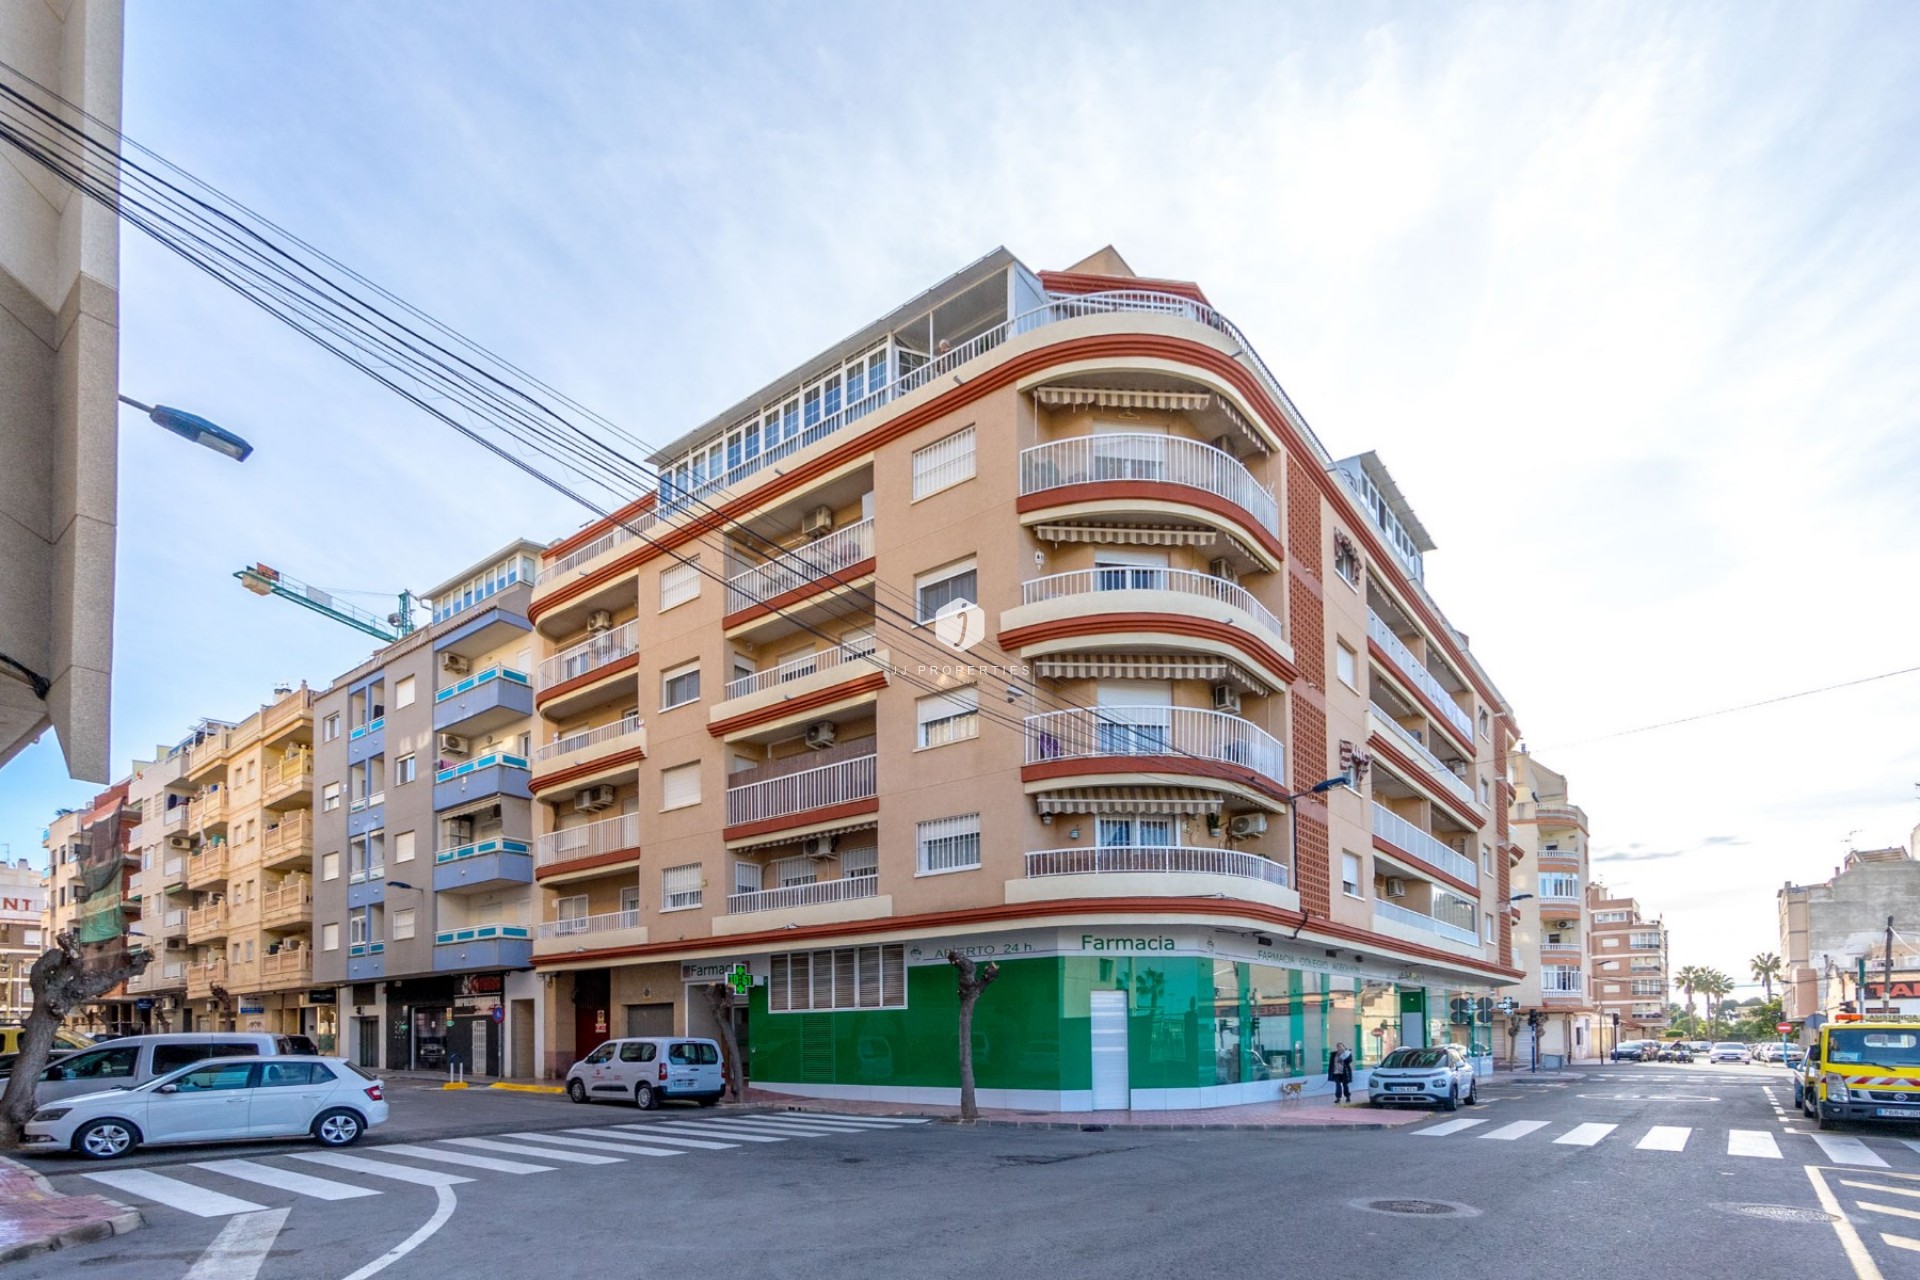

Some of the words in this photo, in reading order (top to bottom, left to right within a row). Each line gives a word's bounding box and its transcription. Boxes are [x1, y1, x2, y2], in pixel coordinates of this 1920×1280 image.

[935, 945, 995, 959] ABERTO
[1003, 943, 1019, 953] 24
[1081, 934, 1175, 951] Farmacia
[1258, 950, 1295, 965] FARMACIA
[1299, 957, 1329, 970] COLEGIO
